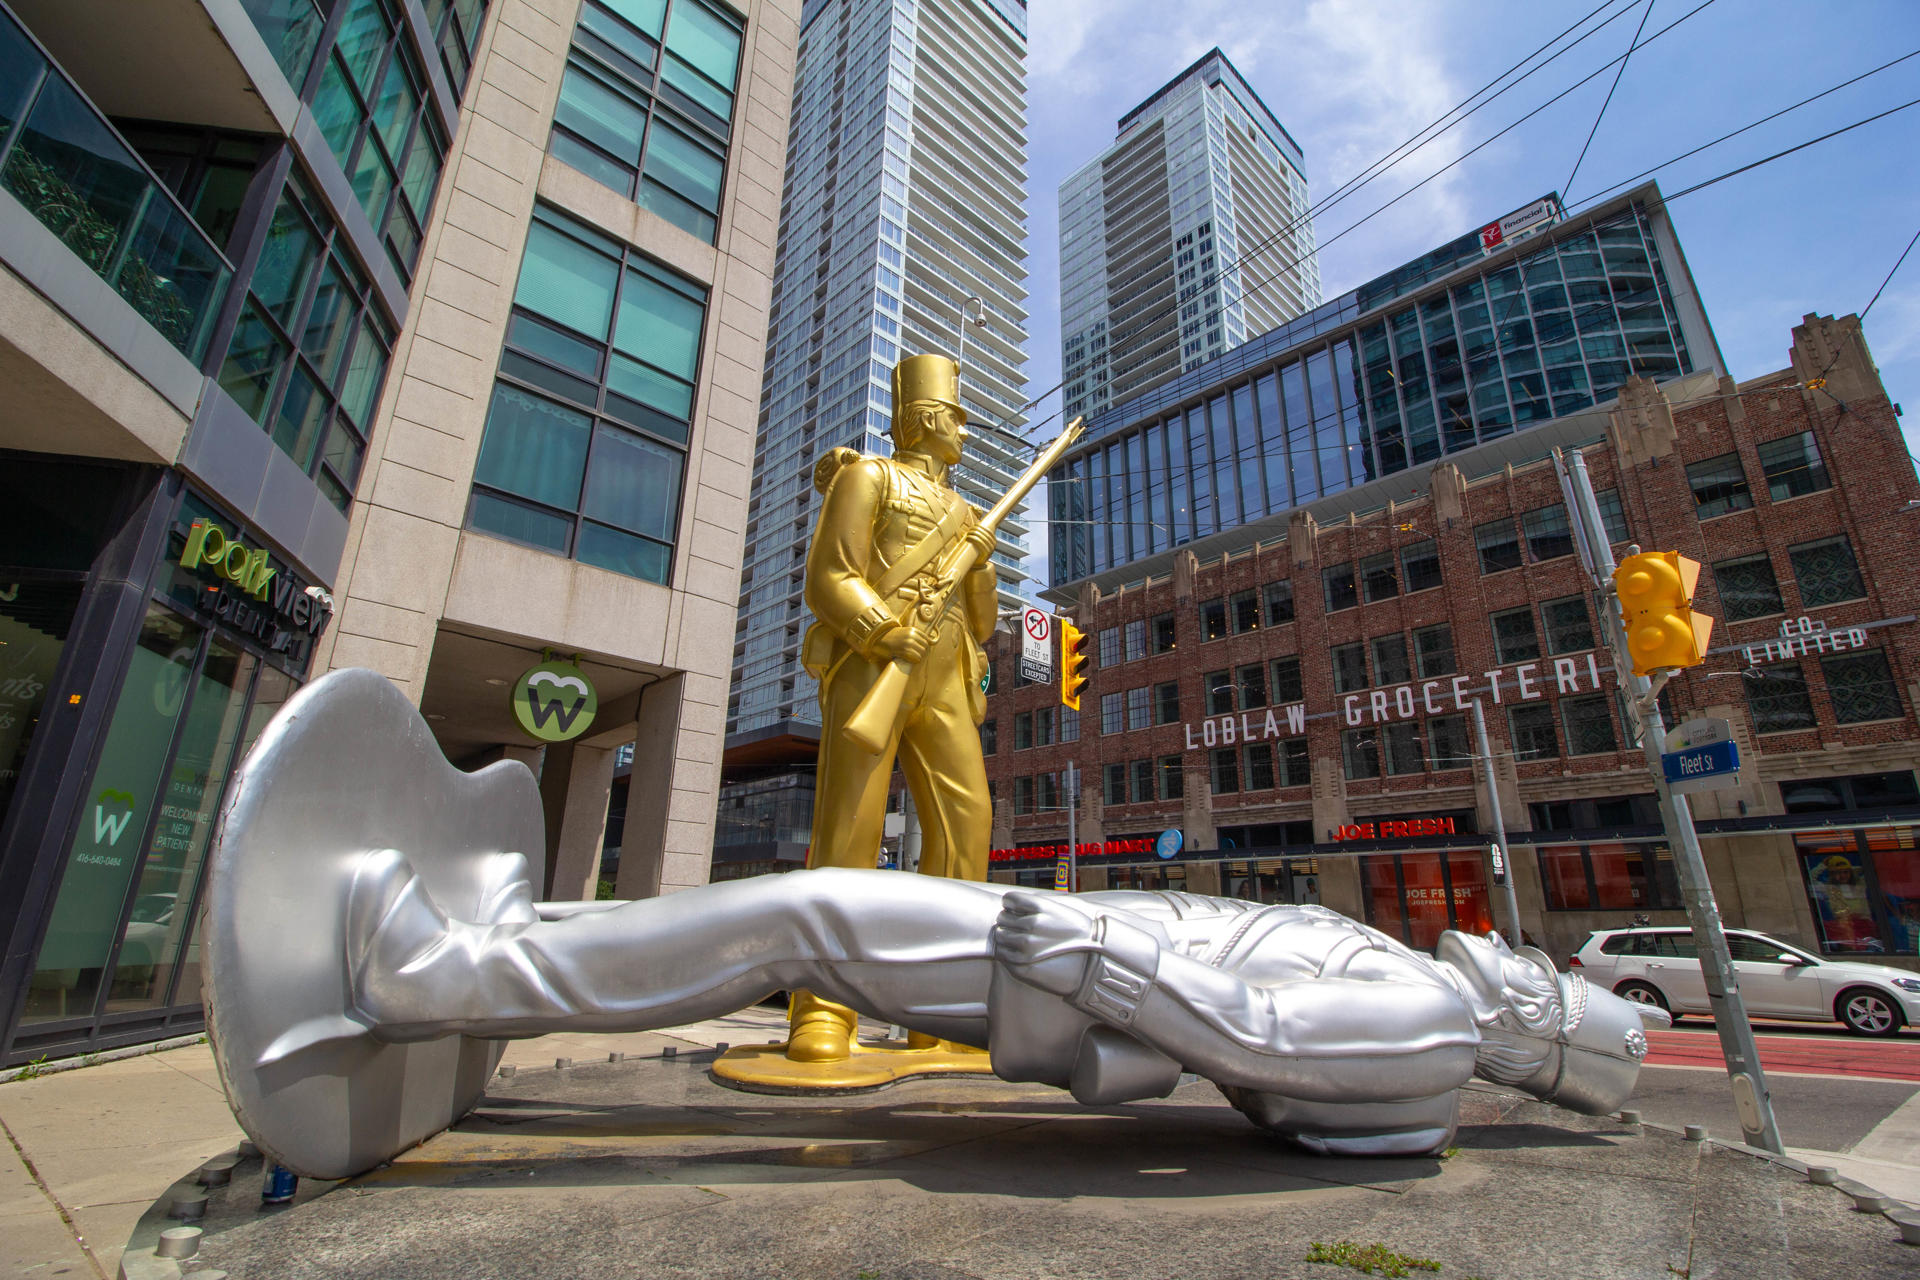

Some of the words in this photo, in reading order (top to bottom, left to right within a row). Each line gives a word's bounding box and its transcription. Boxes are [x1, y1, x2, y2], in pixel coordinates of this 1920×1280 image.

[1503, 207, 1543, 230] financial
[1782, 616, 1822, 637] CO.
[1025, 647, 1040, 659] FLEET
[1042, 653, 1049, 661] ST
[1034, 641, 1041, 650] TO
[1746, 628, 1865, 664] LIMITED
[1022, 660, 1050, 674] STREETCARS
[1025, 669, 1047, 681] EXCEPTED
[1185, 703, 1305, 750] LOBLAW
[1344, 654, 1621, 726] GROCETERI
[1679, 754, 1705, 775] Fleet
[1704, 755, 1714, 770] St
[161, 805, 209, 824] WELCOMING
[170, 823, 192, 836] NEW
[1332, 823, 1376, 841] JOE
[1379, 816, 1456, 838] FRESH
[989, 845, 1056, 861] HOPPERS
[1103, 838, 1155, 855] MART
[1406, 888, 1428, 898] JOE
[1430, 887, 1471, 898] FRSH
